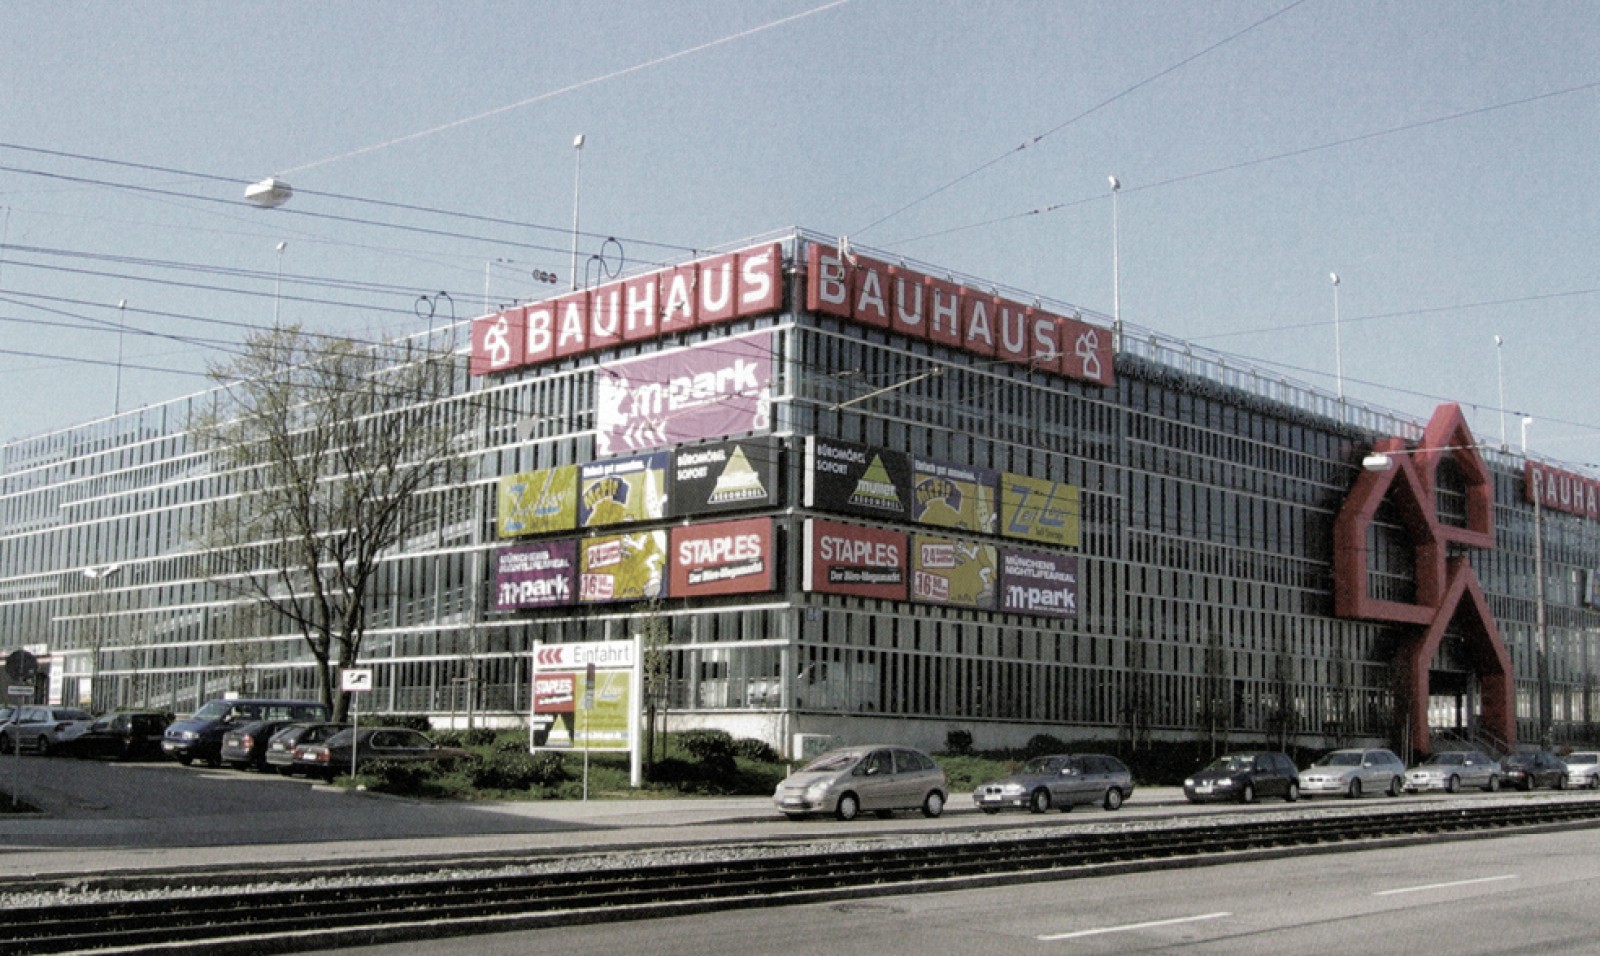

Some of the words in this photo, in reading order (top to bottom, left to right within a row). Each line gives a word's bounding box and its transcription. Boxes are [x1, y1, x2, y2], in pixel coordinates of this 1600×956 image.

[527, 247, 771, 355] BAUHAUS
[819, 254, 1057, 362] BAUHAUS
[679, 533, 761, 565] STAPLES
[820, 535, 899, 567] STAPLES
[573, 645, 629, 663] Einfahrt
